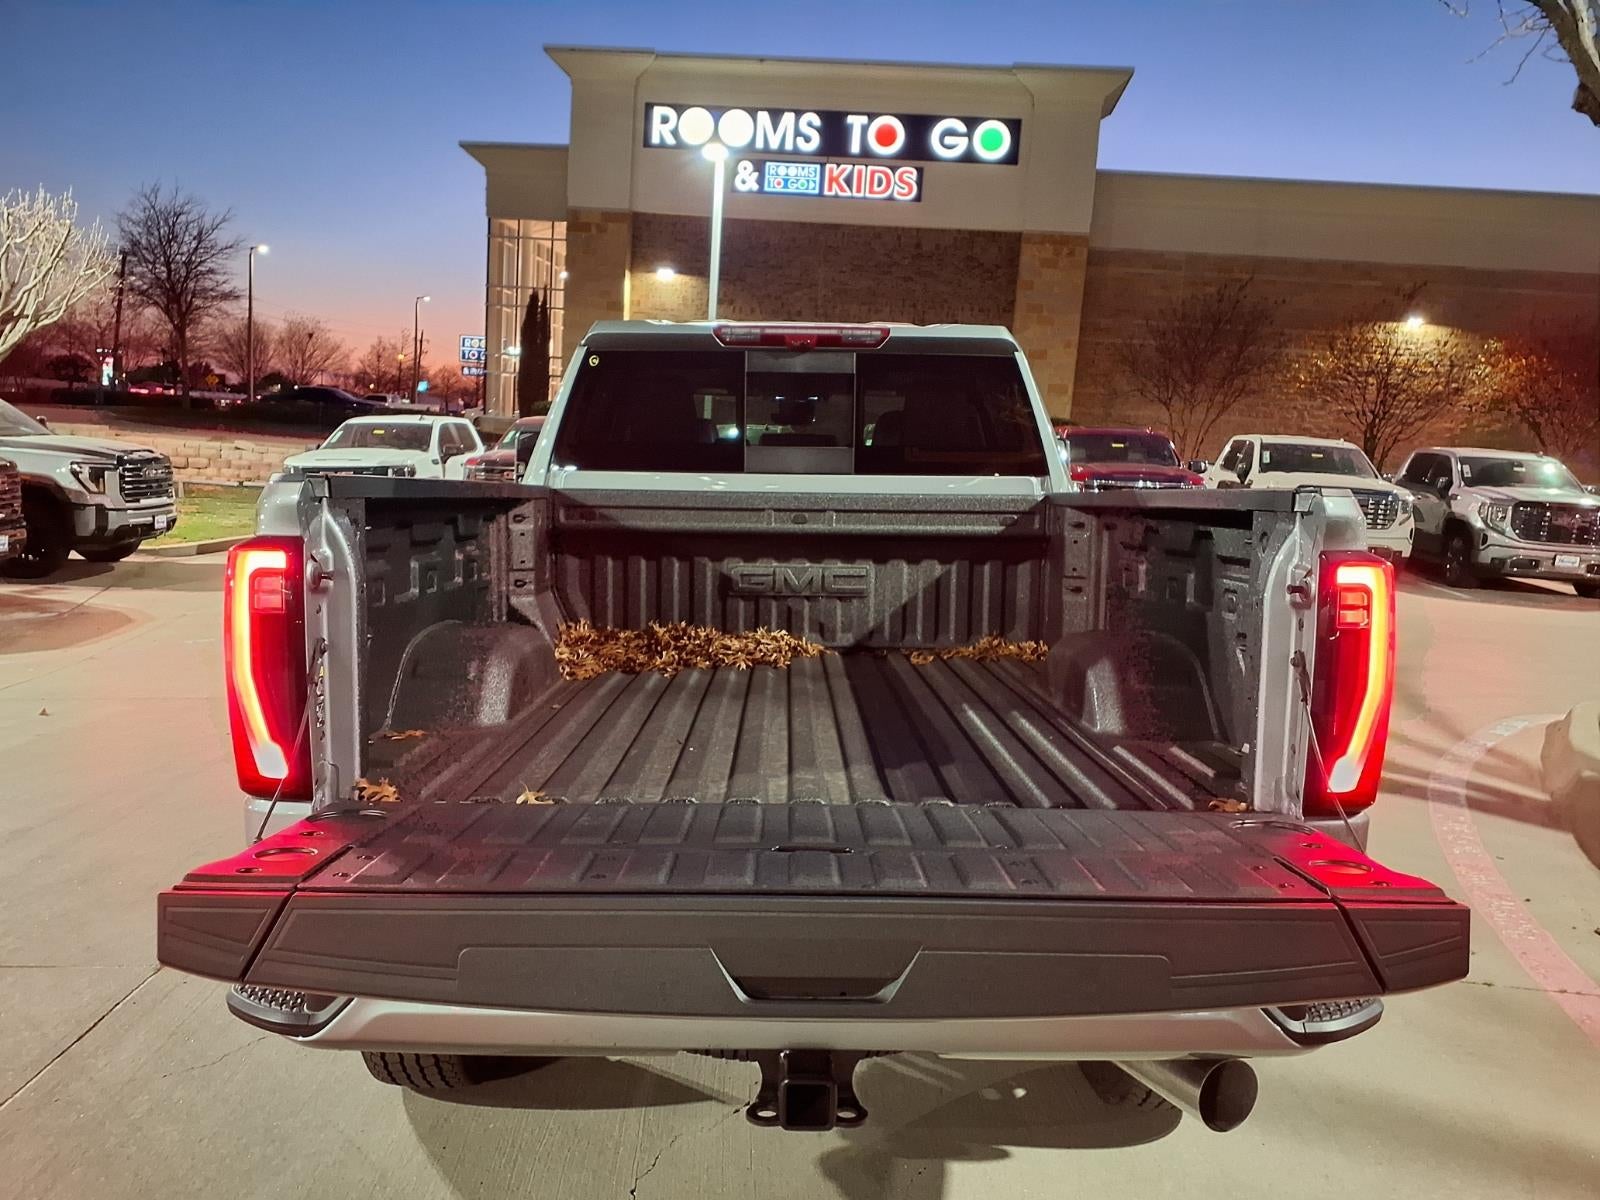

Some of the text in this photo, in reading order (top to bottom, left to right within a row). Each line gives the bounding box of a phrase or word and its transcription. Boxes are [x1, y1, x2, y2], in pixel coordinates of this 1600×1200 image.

[651, 105, 1012, 160] ROOMS TO GO
[734, 159, 760, 192] &
[767, 164, 816, 178] ROOMS
[768, 178, 808, 190] TO GO
[823, 163, 918, 199] KIDS
[731, 566, 868, 594] GMC
